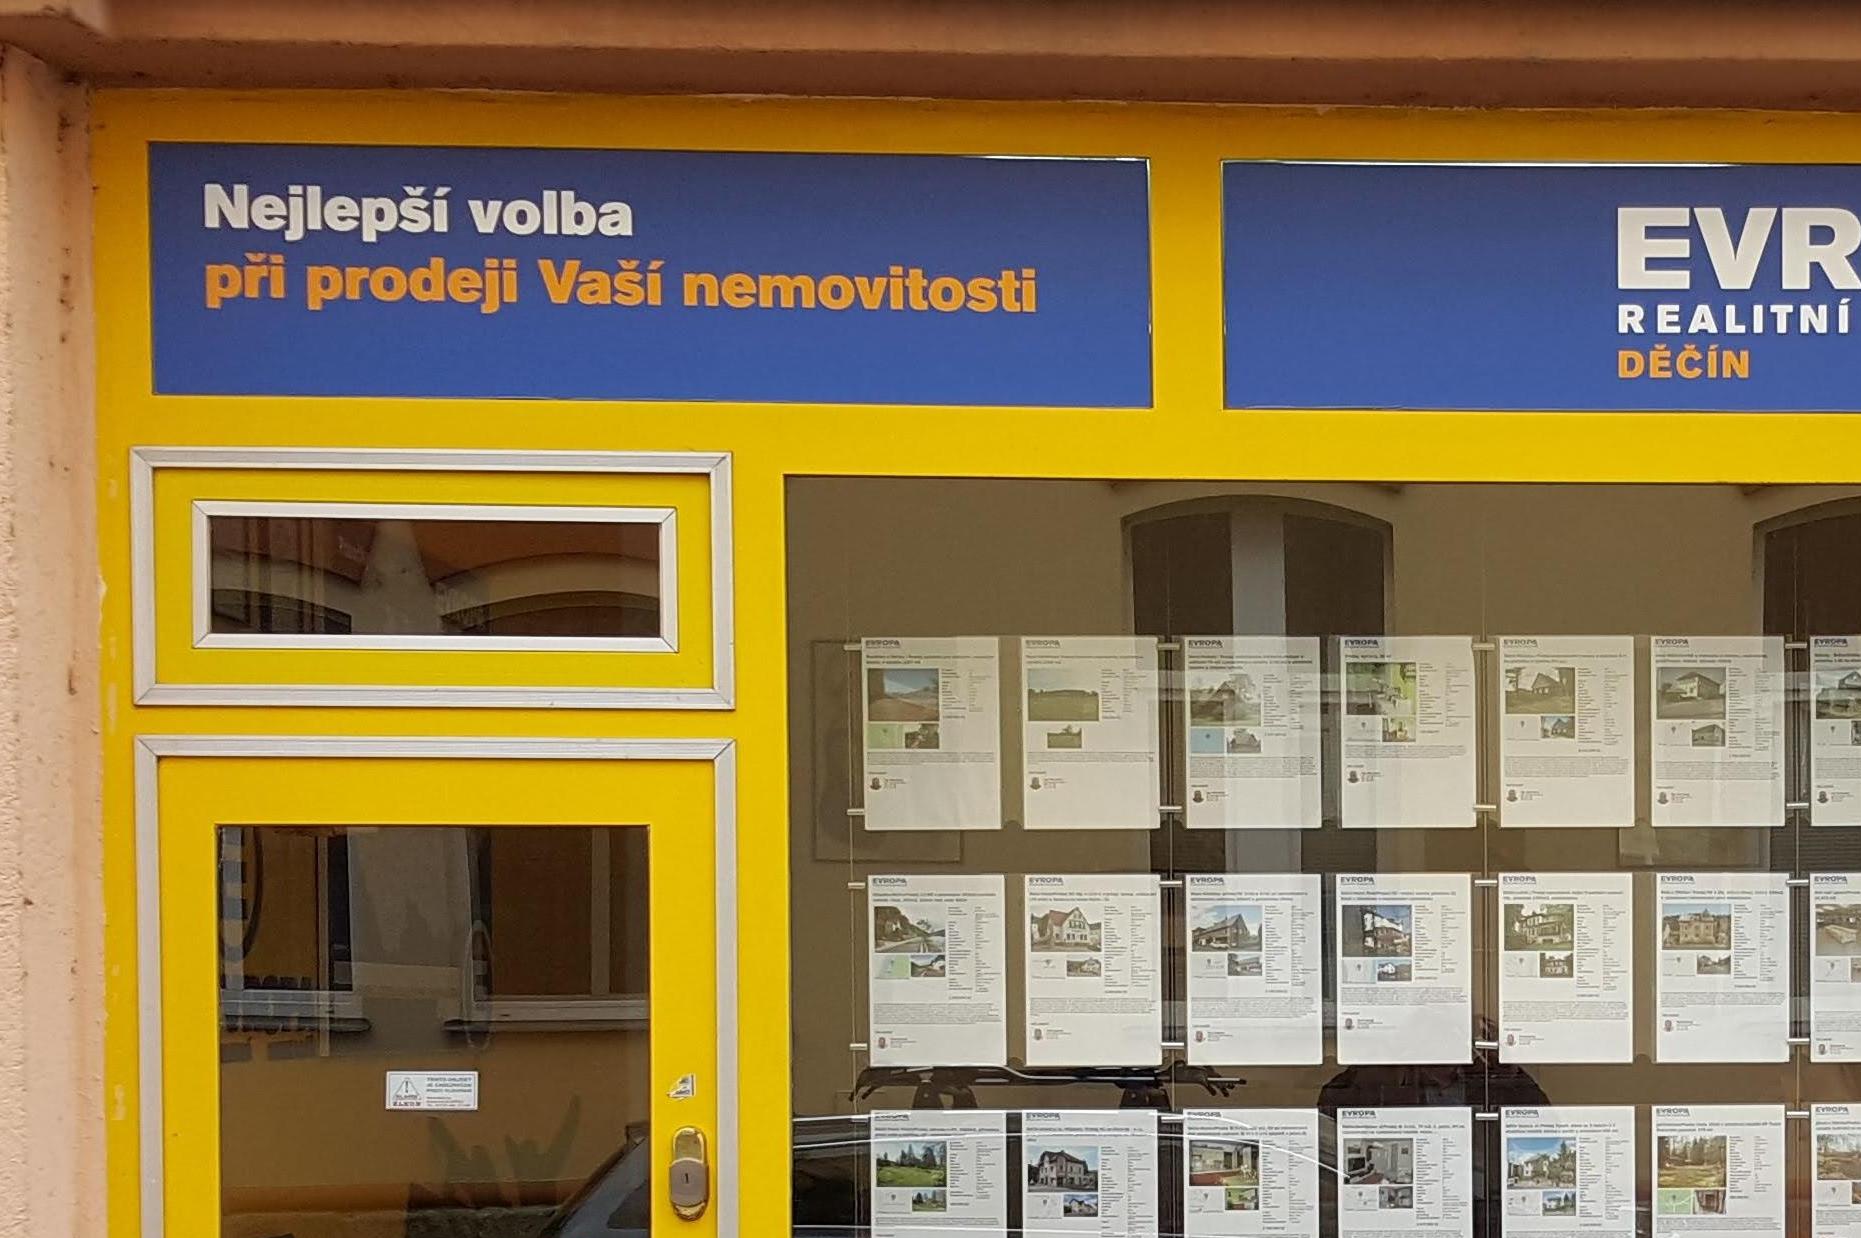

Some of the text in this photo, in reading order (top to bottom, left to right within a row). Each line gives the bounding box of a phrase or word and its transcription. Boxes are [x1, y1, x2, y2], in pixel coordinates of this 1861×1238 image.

[203, 183, 634, 242] Nejlepší volba
[205, 252, 1037, 314] při prodeji Vaší nemovitosti
[1617, 297, 1851, 334] REALITNÍ
[1617, 343, 1750, 379] DĚČÍN
